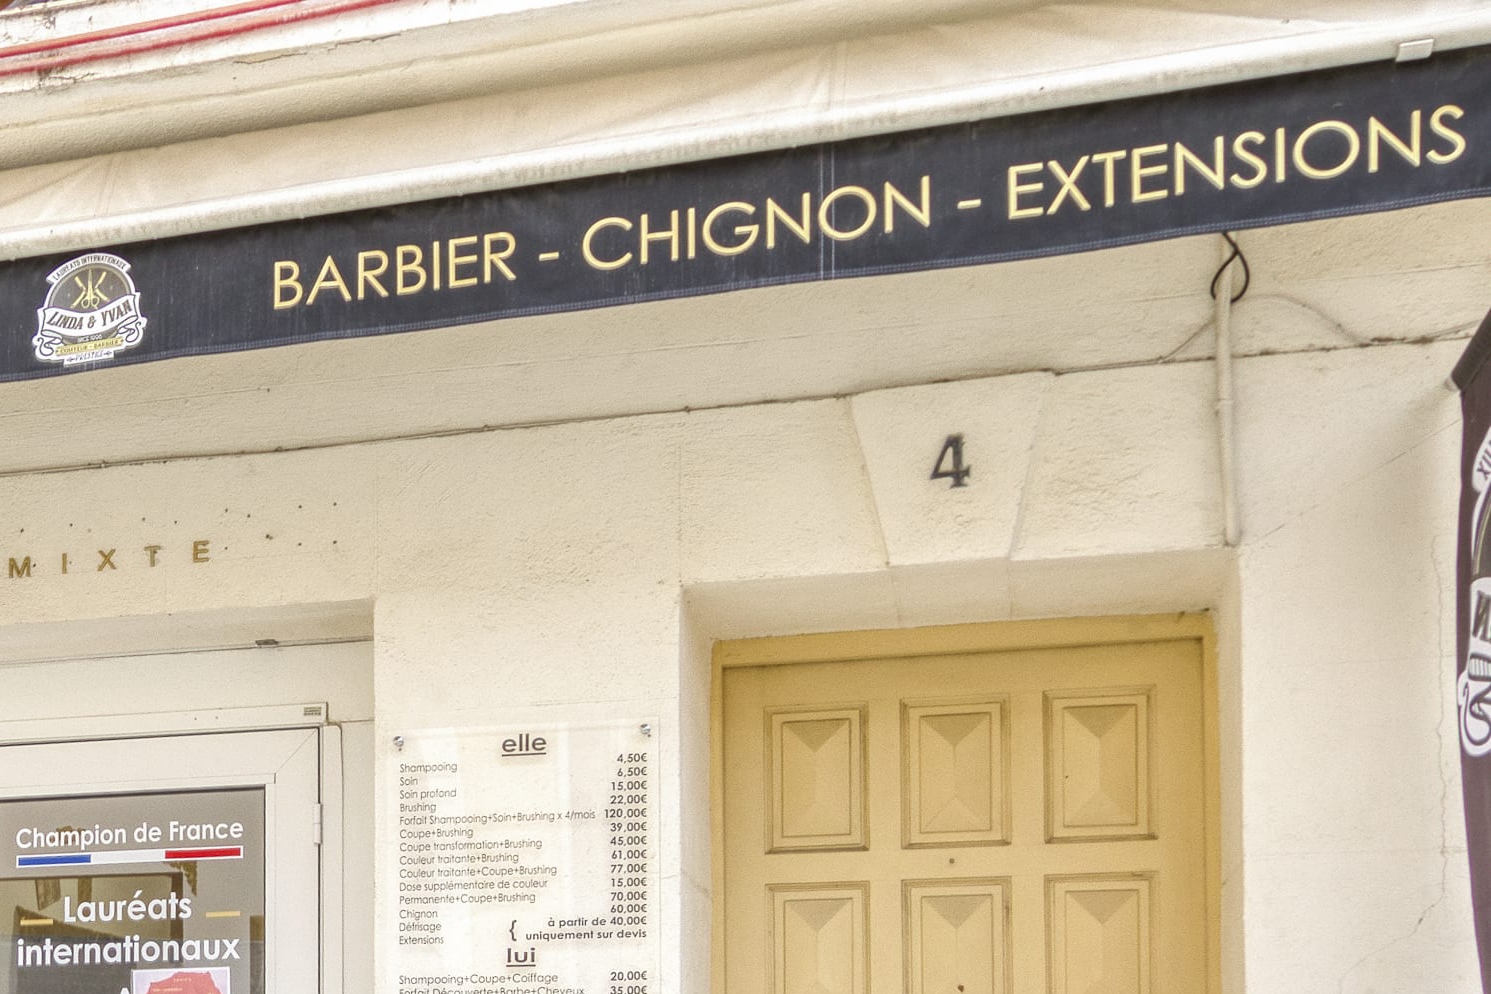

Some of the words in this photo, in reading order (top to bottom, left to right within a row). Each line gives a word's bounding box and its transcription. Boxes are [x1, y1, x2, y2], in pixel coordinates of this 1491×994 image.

[274, 231, 517, 310] BARBIER
[583, 176, 931, 271] CHIGNON
[1008, 105, 1466, 220] EXTENSIONS
[47, 312, 83, 330] LINDA
[88, 316, 96, 328] &
[101, 300, 132, 326] YVAN
[930, 433, 971, 488] 4
[7, 540, 213, 581] MIXTE
[502, 734, 547, 752] elle
[617, 753, 647, 764] 4,50€
[399, 762, 458, 774] Shampooing
[617, 767, 647, 778] 6,50€
[399, 777, 418, 786] Soin
[611, 781, 647, 792] 15,00€
[399, 790, 418, 799] Soin
[420, 788, 457, 800] profond
[610, 795, 647, 806] 22,00€
[400, 803, 436, 813] Brushing
[604, 808, 647, 820] 120,00€
[399, 816, 427, 825] Forfait
[429, 812, 555, 825] Shampooing+Soin+Brushing
[565, 810, 595, 821] 4/mois
[399, 828, 474, 839] Coupe+Brushing
[610, 822, 647, 834] 39,00€
[16, 824, 127, 850] Champion
[134, 823, 161, 843] de
[170, 821, 243, 840] France
[610, 836, 647, 847] 45,00€
[399, 842, 431, 853] Coupe
[433, 839, 542, 851] transformation+Brushing
[399, 855, 435, 865] Couleur
[437, 853, 519, 864] traitante+Brushing
[611, 850, 647, 861] 61,00€
[399, 869, 435, 878] Couleur
[437, 865, 557, 878] traitante+Coupe+Brushing
[610, 864, 647, 875] 77,00€
[399, 882, 422, 892] Dose
[424, 880, 494, 892] supplémentaire
[497, 880, 510, 889] de
[512, 879, 548, 889] couleur
[611, 878, 647, 889] 15,00€
[399, 893, 536, 905] Permanente+Coupe+Brushing
[611, 892, 647, 903] 70,00€
[64, 890, 192, 923] Lauréats
[610, 904, 647, 915] 60,00€
[399, 909, 438, 920] Chignon
[399, 922, 442, 933] Défrisage
[548, 917, 555, 927] à
[559, 917, 588, 929] partir
[592, 917, 607, 927] de
[610, 916, 647, 927] 40,00€
[399, 935, 444, 945] Extensions
[526, 930, 593, 941] uniquement
[597, 931, 613, 939] sur
[617, 929, 646, 939] devis
[17, 935, 240, 966] internationaux
[507, 948, 535, 962] lui
[399, 974, 558, 986] Shampooing+Coupe+Coiffage
[610, 971, 647, 982] 20,00€
